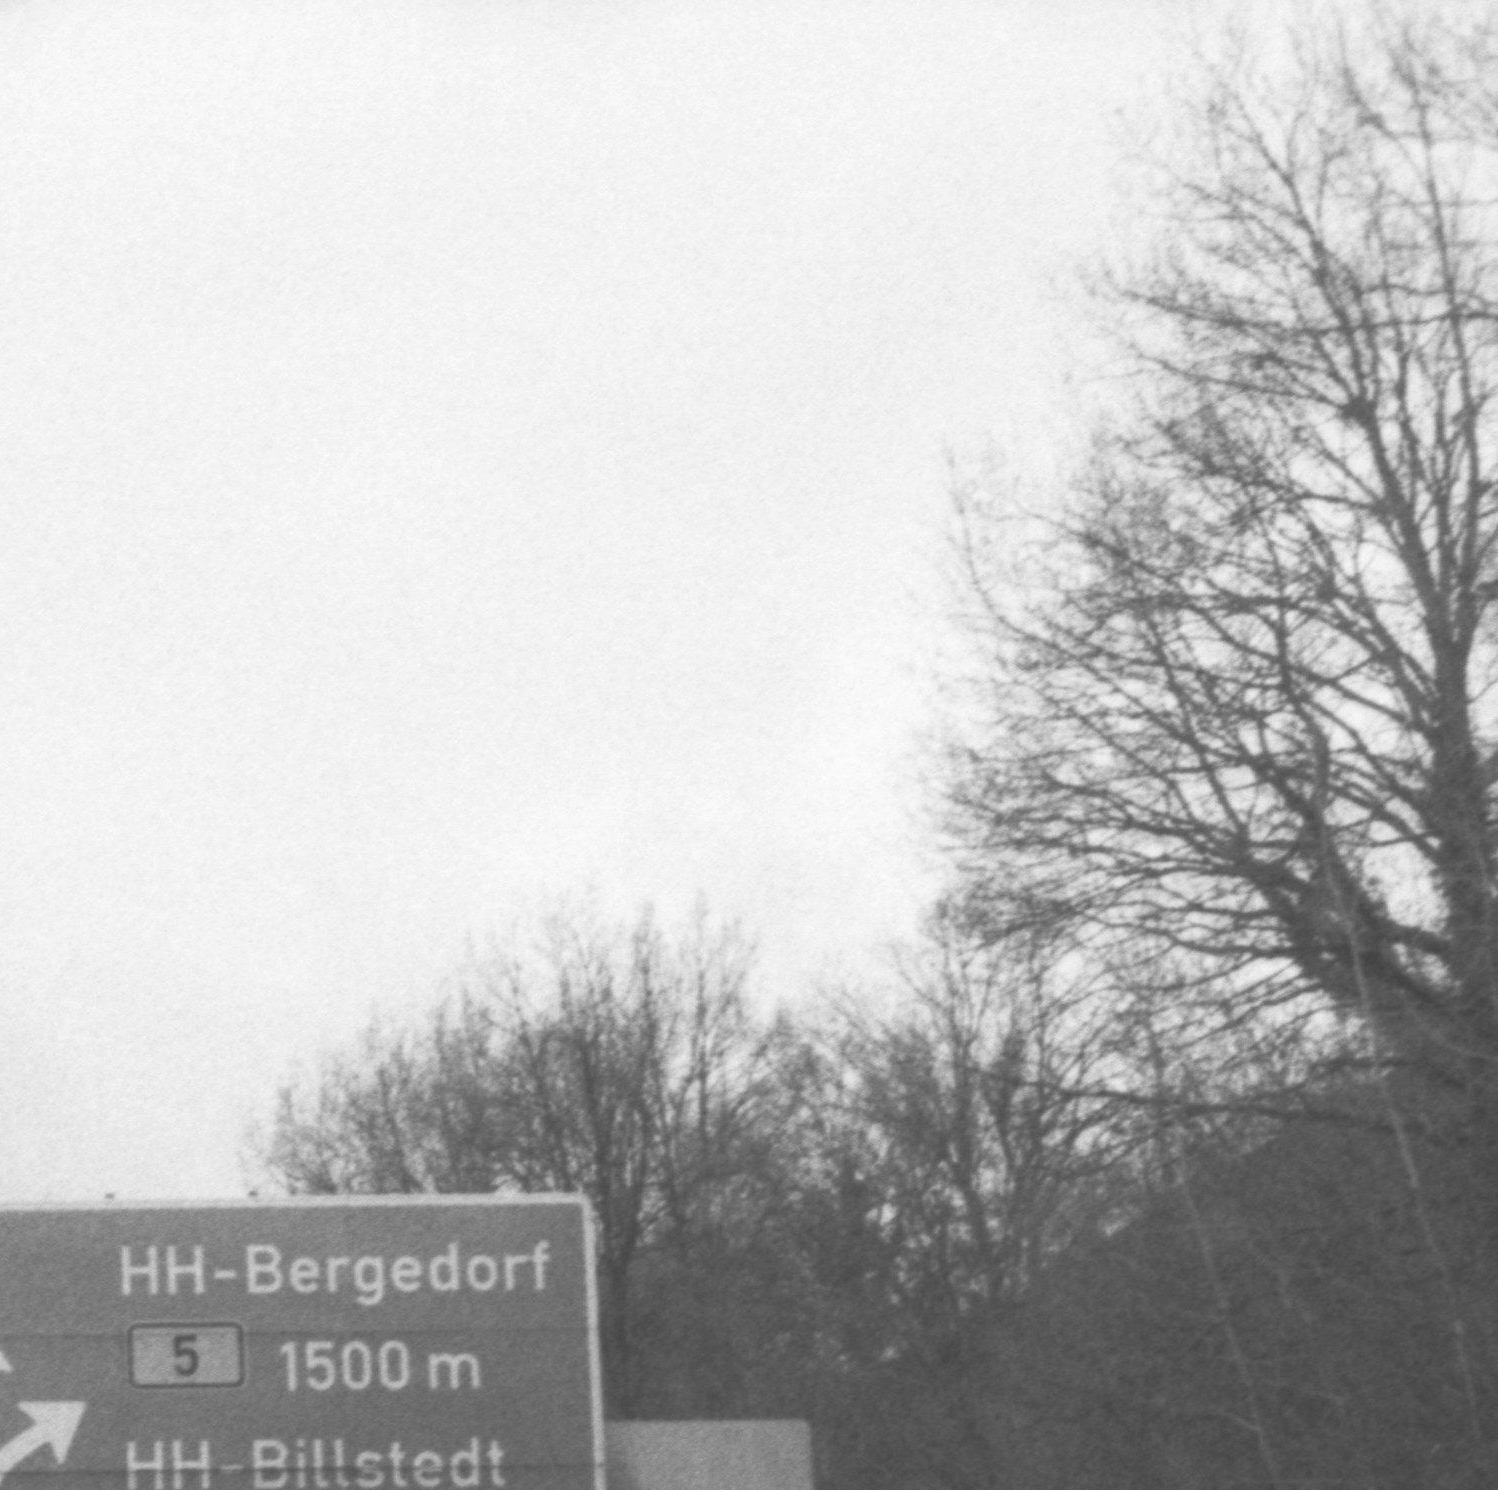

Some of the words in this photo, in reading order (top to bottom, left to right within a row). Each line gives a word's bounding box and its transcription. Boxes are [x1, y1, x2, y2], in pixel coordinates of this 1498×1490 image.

[119, 1241, 549, 1306] HH-Bergedorf
[172, 1334, 200, 1377] 5
[280, 1340, 411, 1391] 1500
[427, 1352, 481, 1389] m
[125, 1438, 505, 1490] HH-Billstedt
